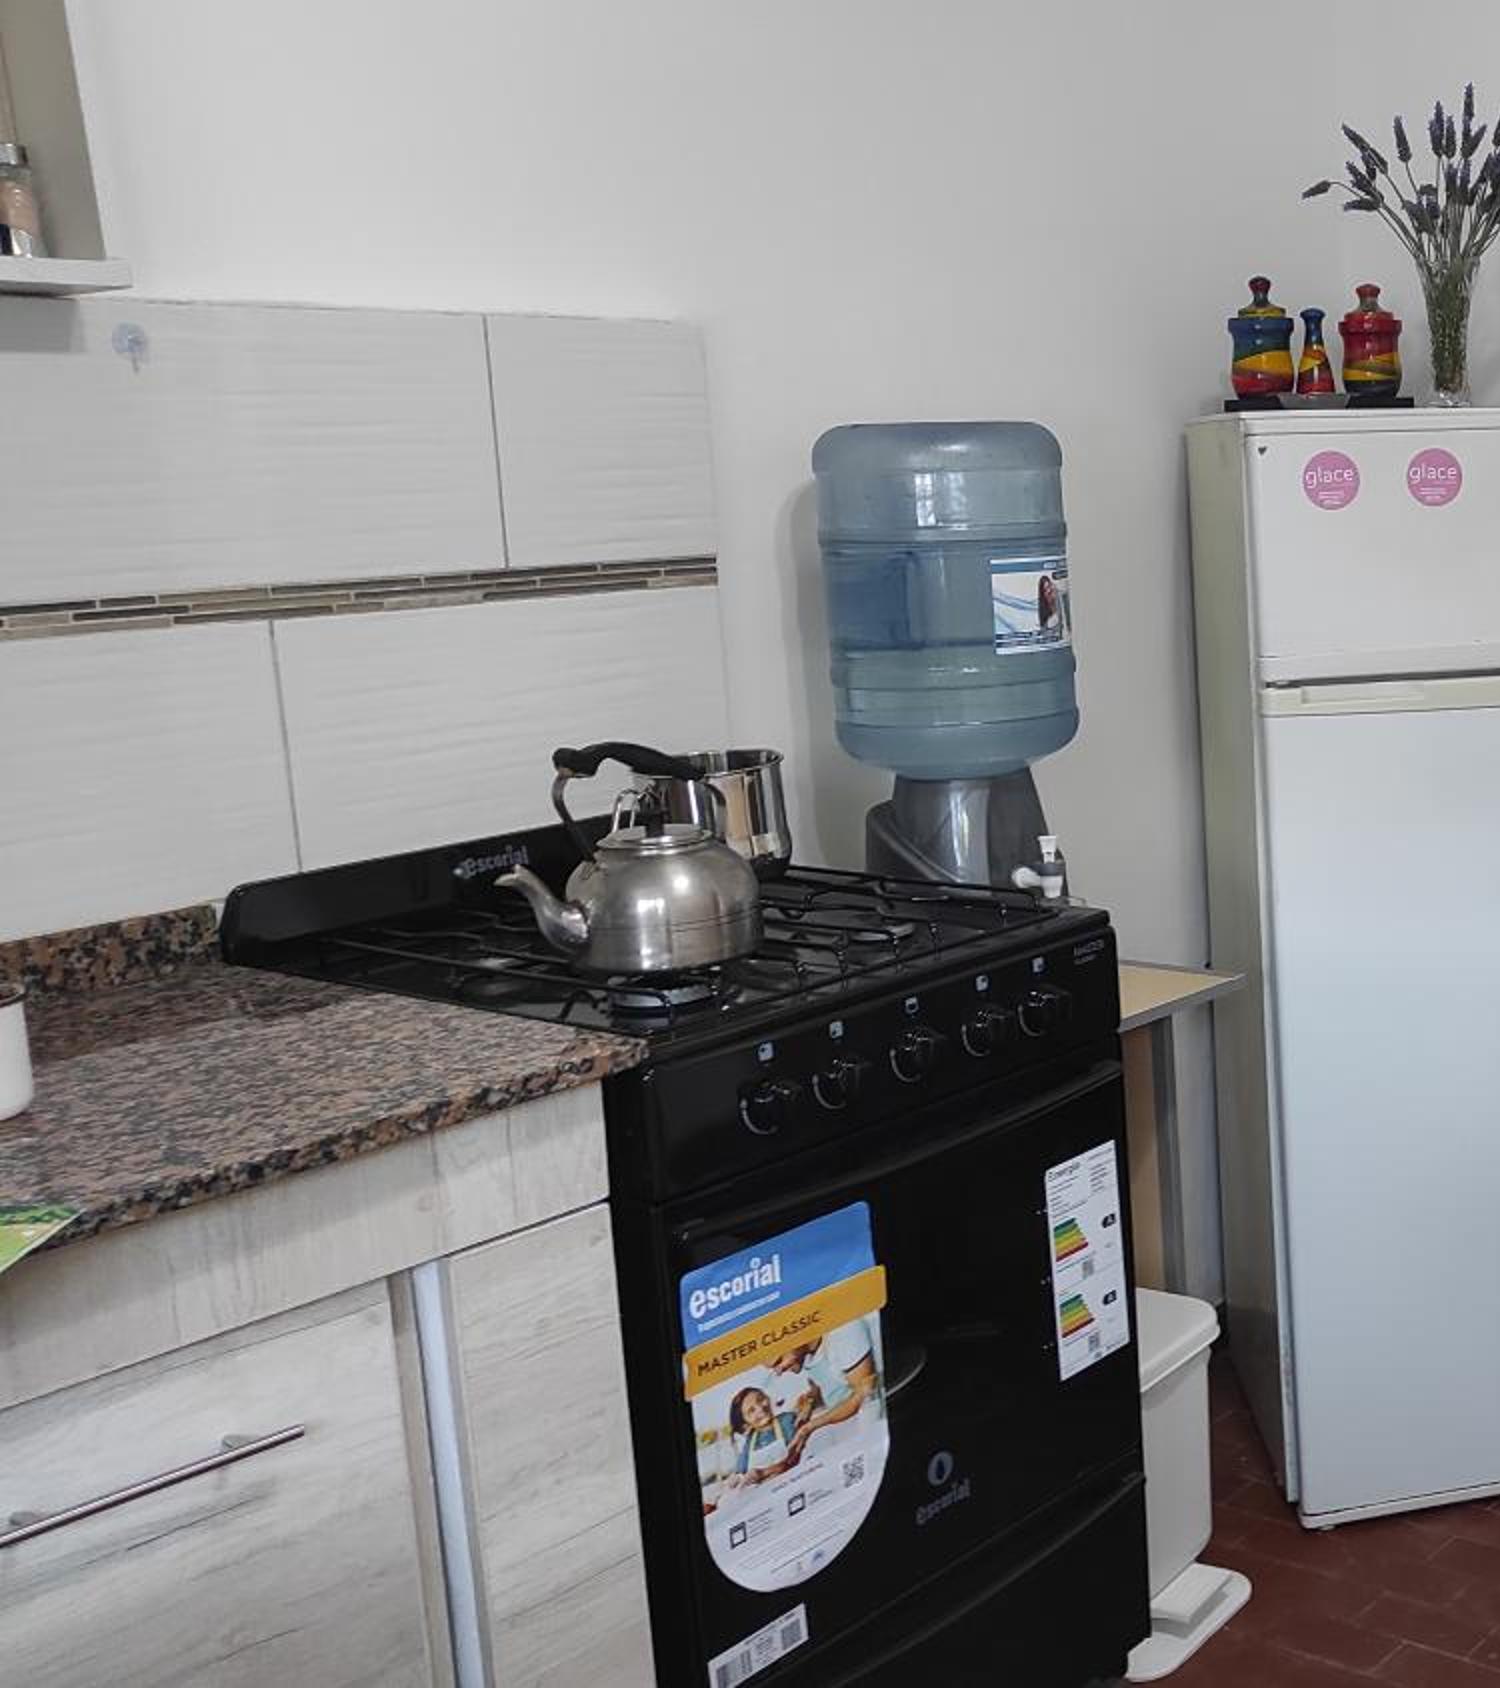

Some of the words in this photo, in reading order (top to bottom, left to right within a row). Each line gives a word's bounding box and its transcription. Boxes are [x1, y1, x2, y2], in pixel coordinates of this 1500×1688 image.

[1304, 466, 1355, 489] glace
[1408, 462, 1458, 484] glace
[462, 845, 529, 880] escorial
[688, 1253, 783, 1320] escorial
[696, 1340, 759, 1378] MASTER
[761, 1310, 826, 1348] CLASSIC
